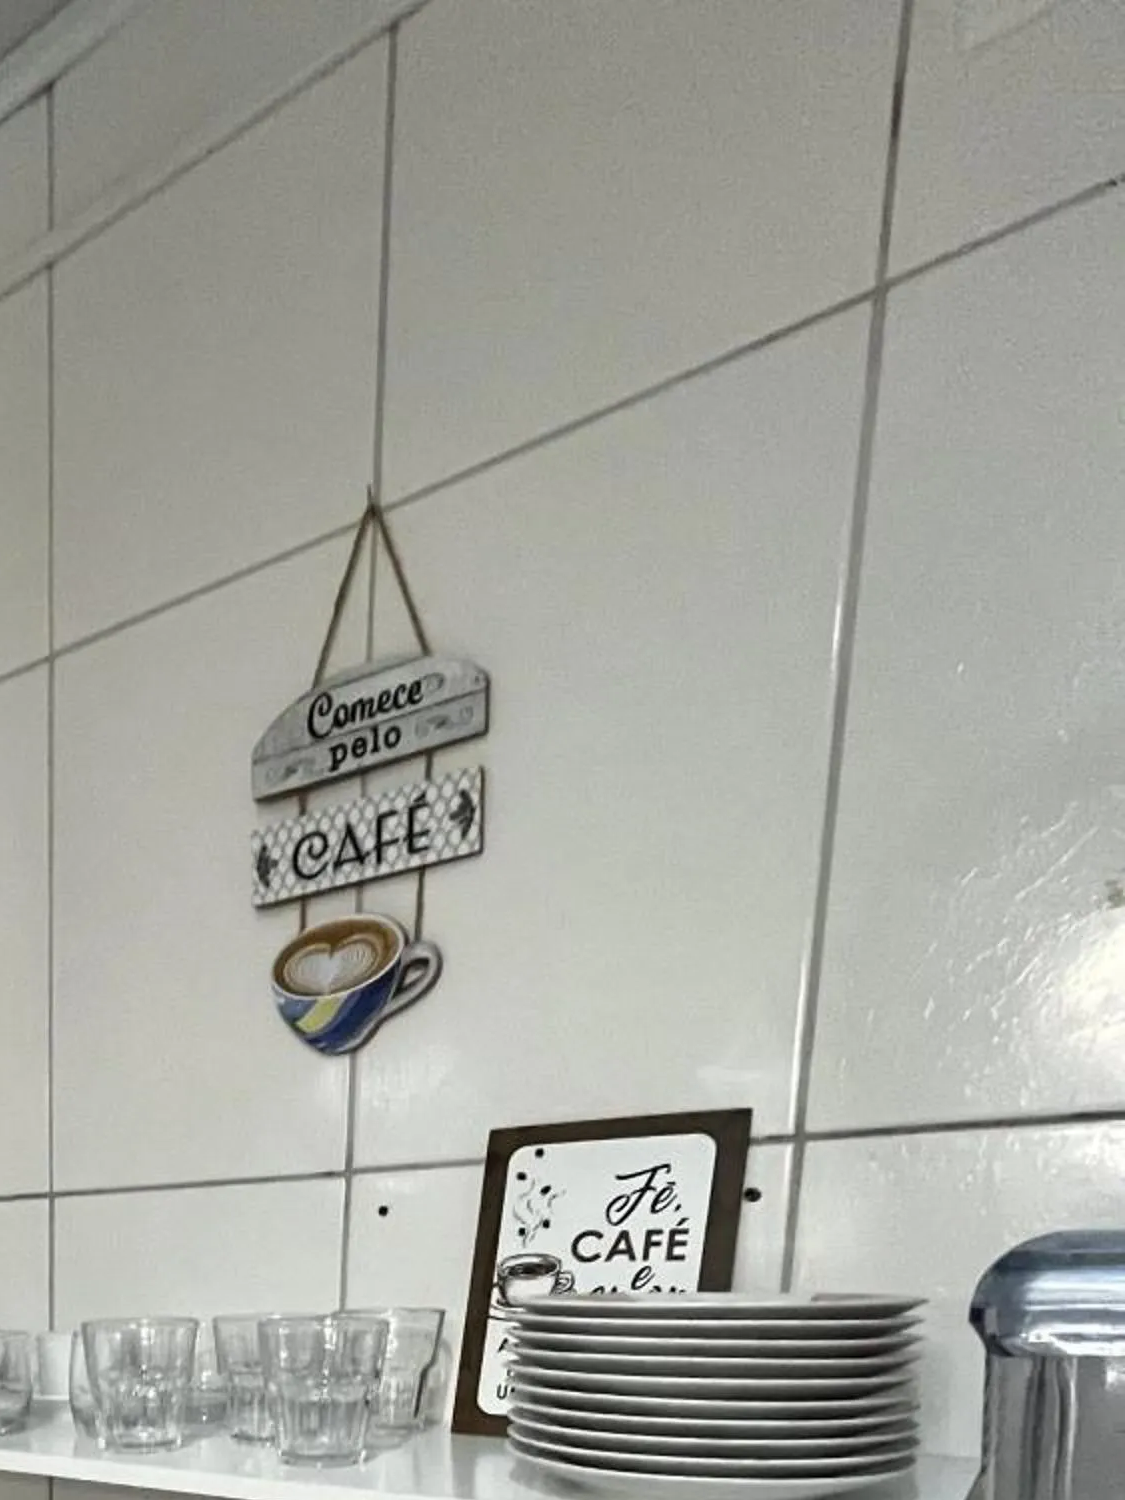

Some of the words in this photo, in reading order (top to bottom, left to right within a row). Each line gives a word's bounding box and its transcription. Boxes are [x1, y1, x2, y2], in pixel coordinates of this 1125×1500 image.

[307, 679, 424, 739] Comece
[329, 725, 402, 772] pelo
[291, 792, 431, 880] CAFÉ
[571, 1217, 690, 1263] CAFÉ
[631, 1265, 656, 1290] e
